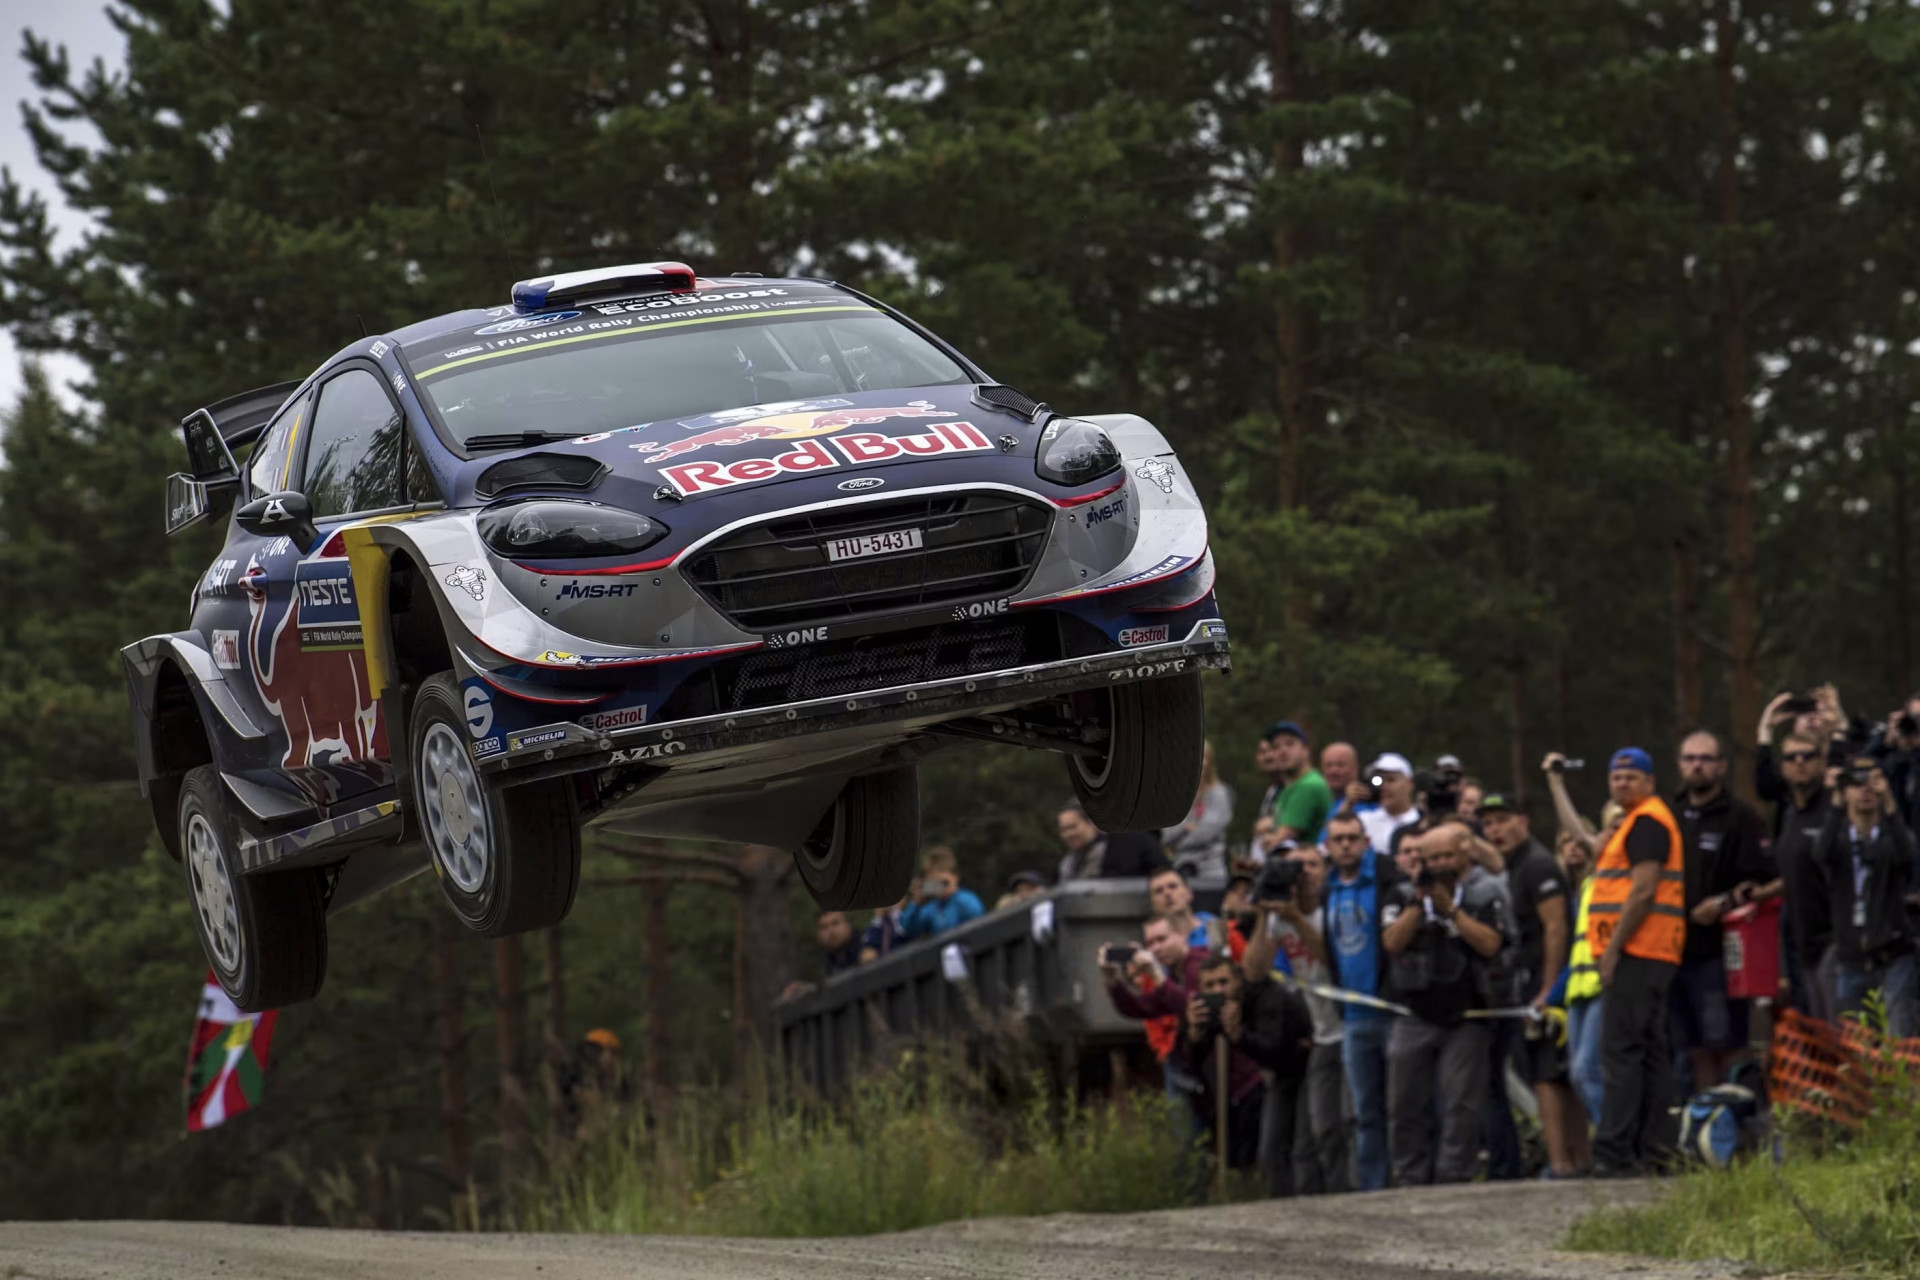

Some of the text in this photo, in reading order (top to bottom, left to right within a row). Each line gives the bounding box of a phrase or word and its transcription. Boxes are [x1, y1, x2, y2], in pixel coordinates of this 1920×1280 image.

[597, 288, 788, 316] EcoBoost
[497, 313, 564, 332] Ford
[497, 336, 528, 348] FIA
[530, 324, 584, 341] World
[588, 316, 632, 331] Rally
[637, 301, 760, 323] Championship
[657, 421, 995, 497] Red Bull
[1093, 499, 1126, 525] MS-RT
[270, 536, 291, 557] ONE
[835, 530, 914, 558] HU-5431
[300, 577, 352, 607] NESTE
[570, 583, 639, 600] MS-RT
[968, 598, 1009, 618] ONE
[786, 626, 829, 646] ONE
[1131, 626, 1167, 645] Castrol
[595, 709, 644, 730] Castrol
[523, 730, 566, 744] MICHELIN
